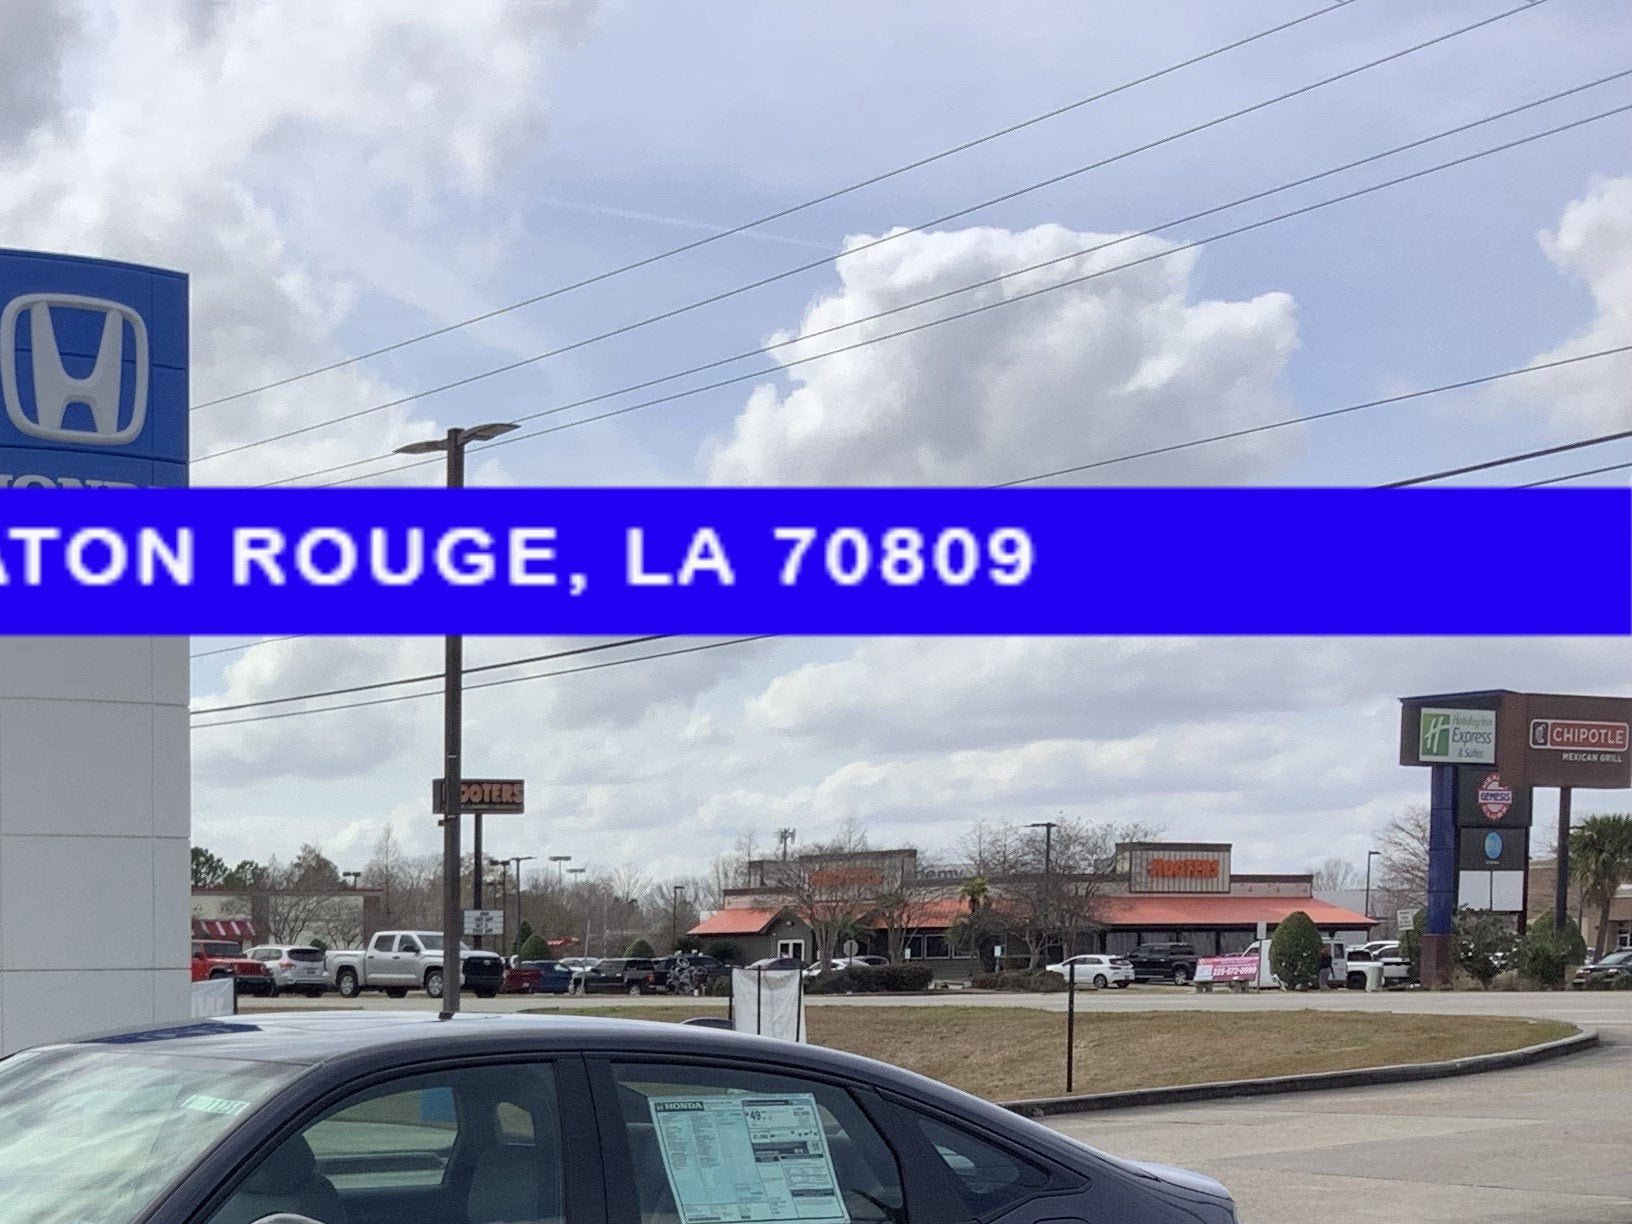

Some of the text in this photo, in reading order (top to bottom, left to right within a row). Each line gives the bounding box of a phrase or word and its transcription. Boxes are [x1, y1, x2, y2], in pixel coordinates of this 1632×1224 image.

[1452, 727, 1492, 747] Express
[1553, 727, 1624, 744] CHIPOTLE
[1562, 752, 1623, 762] MEXICAN GRILL
[664, 1102, 703, 1111] HONDA
